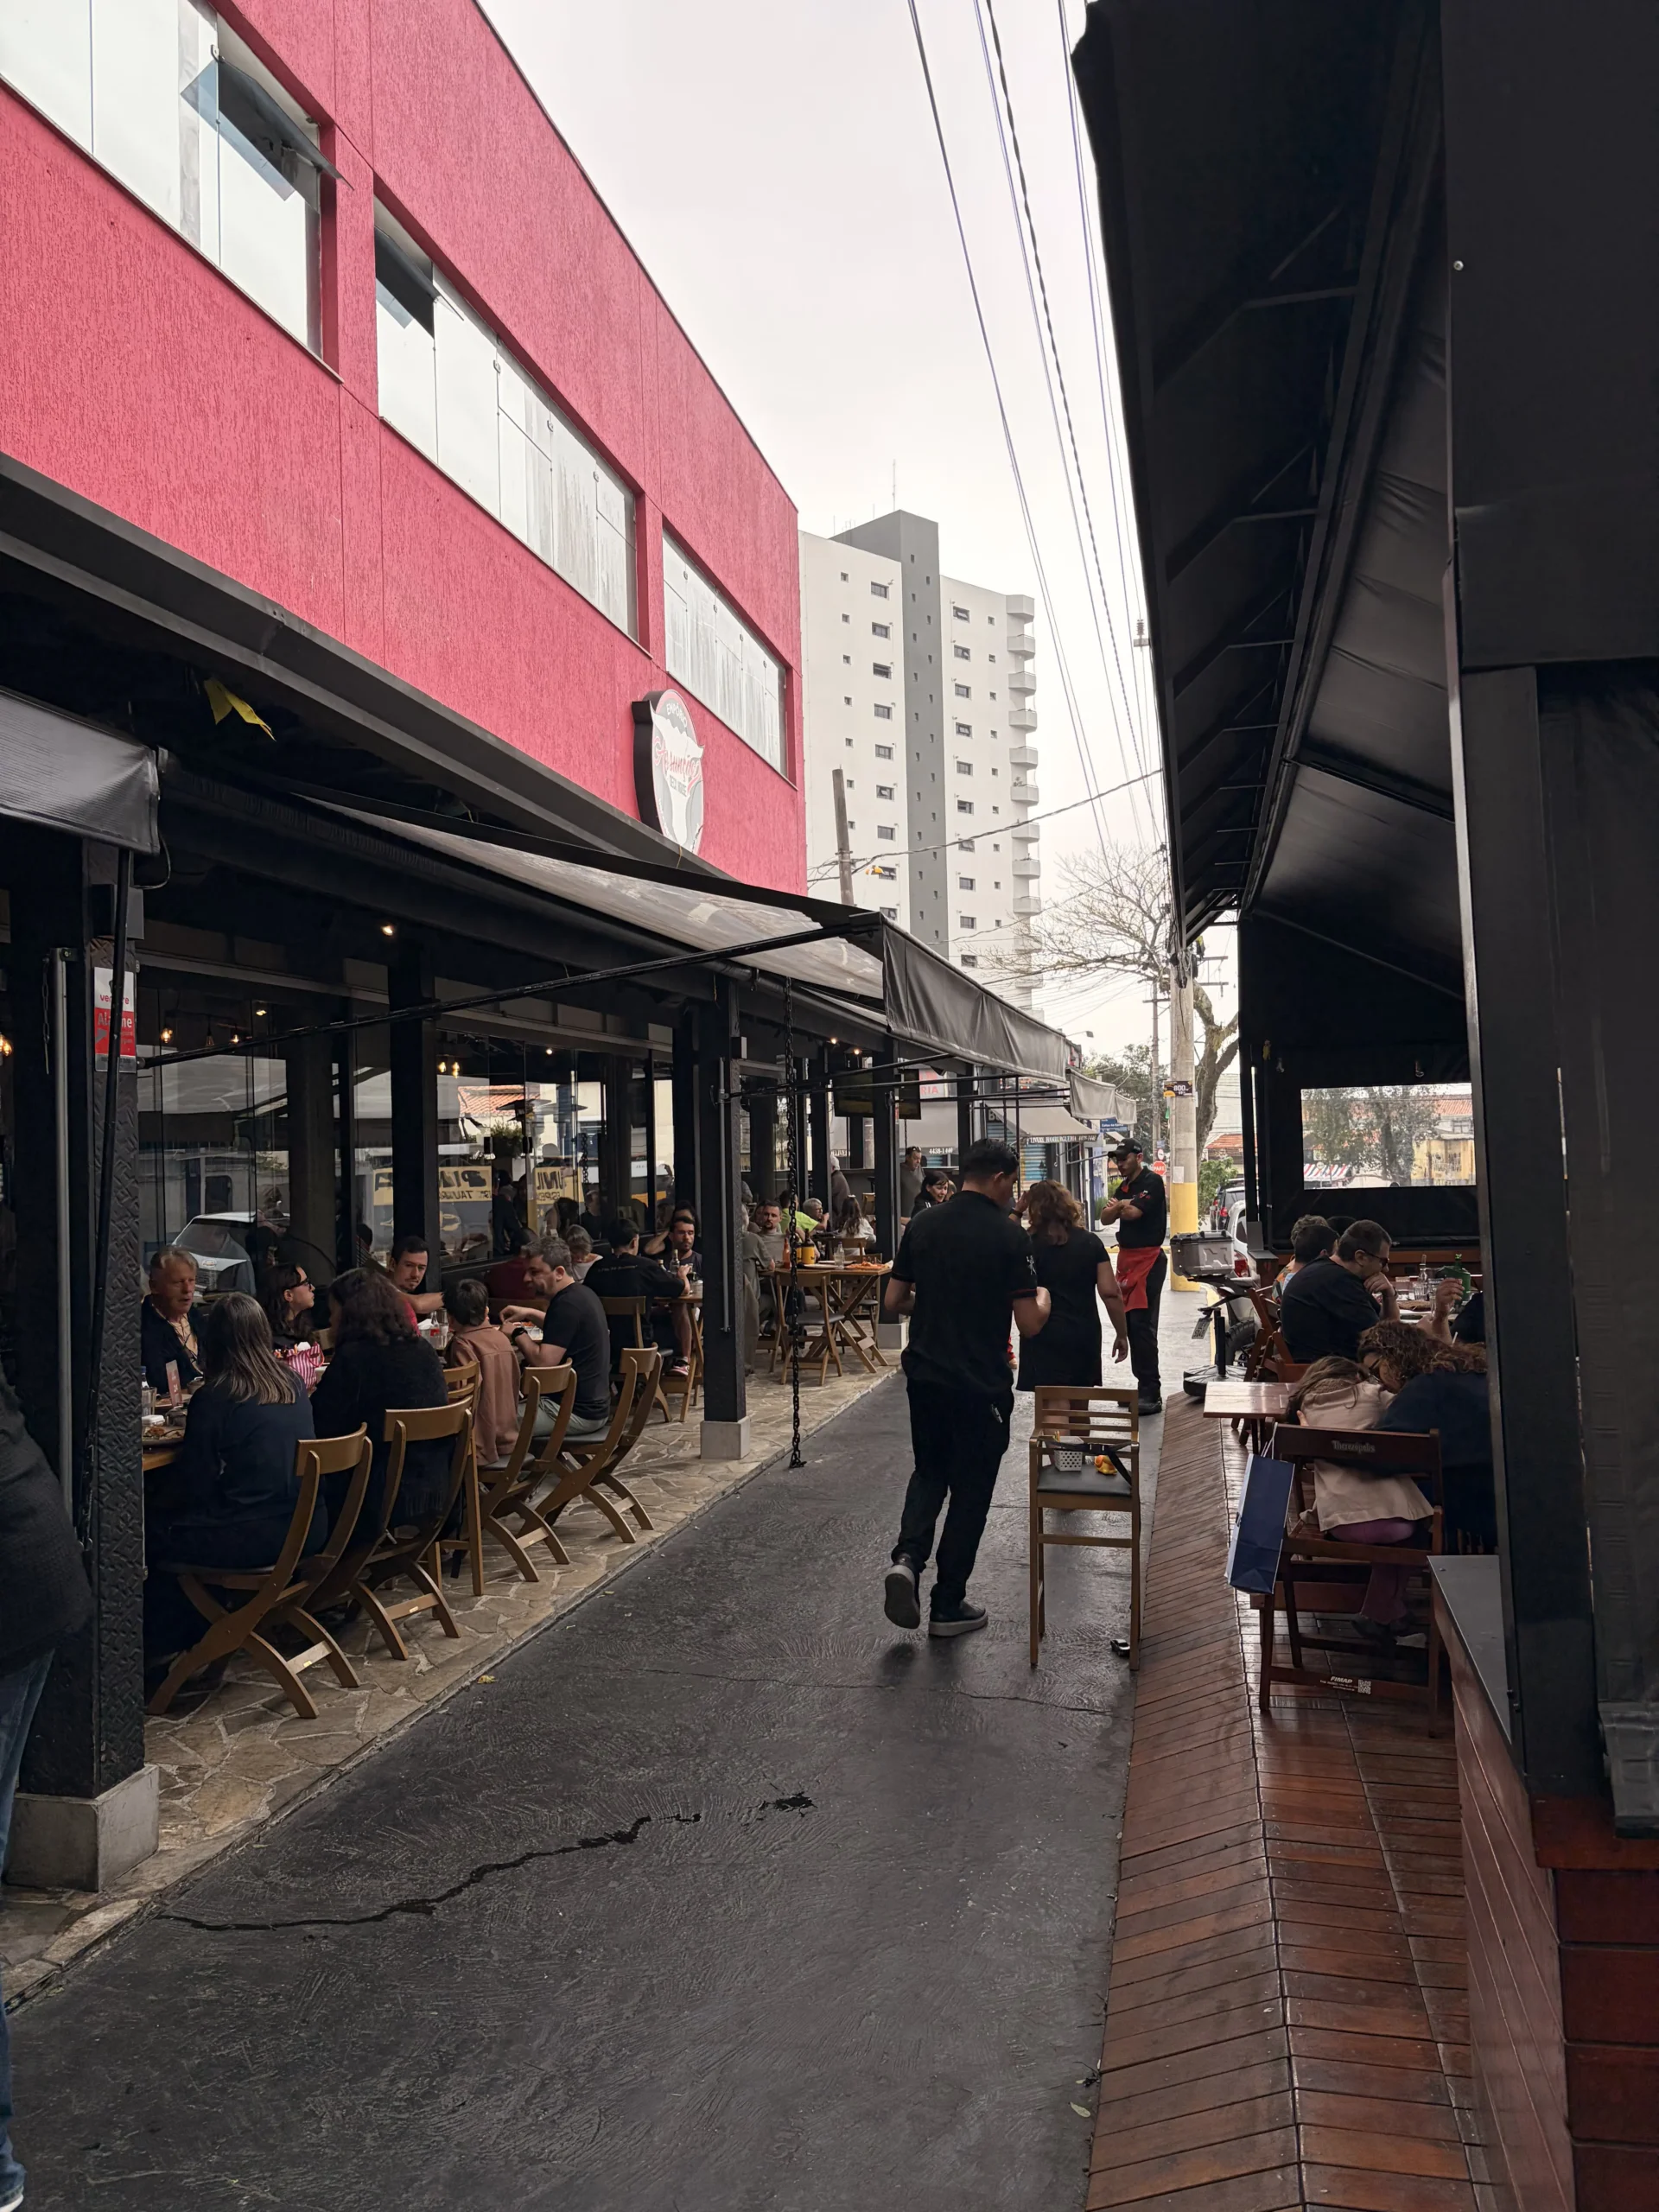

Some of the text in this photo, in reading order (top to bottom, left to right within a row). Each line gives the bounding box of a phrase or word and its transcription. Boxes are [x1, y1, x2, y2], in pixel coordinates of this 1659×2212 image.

[99, 994, 130, 1005] vere
[98, 1012, 132, 1028] Alme
[920, 1085, 939, 1096] RIA
